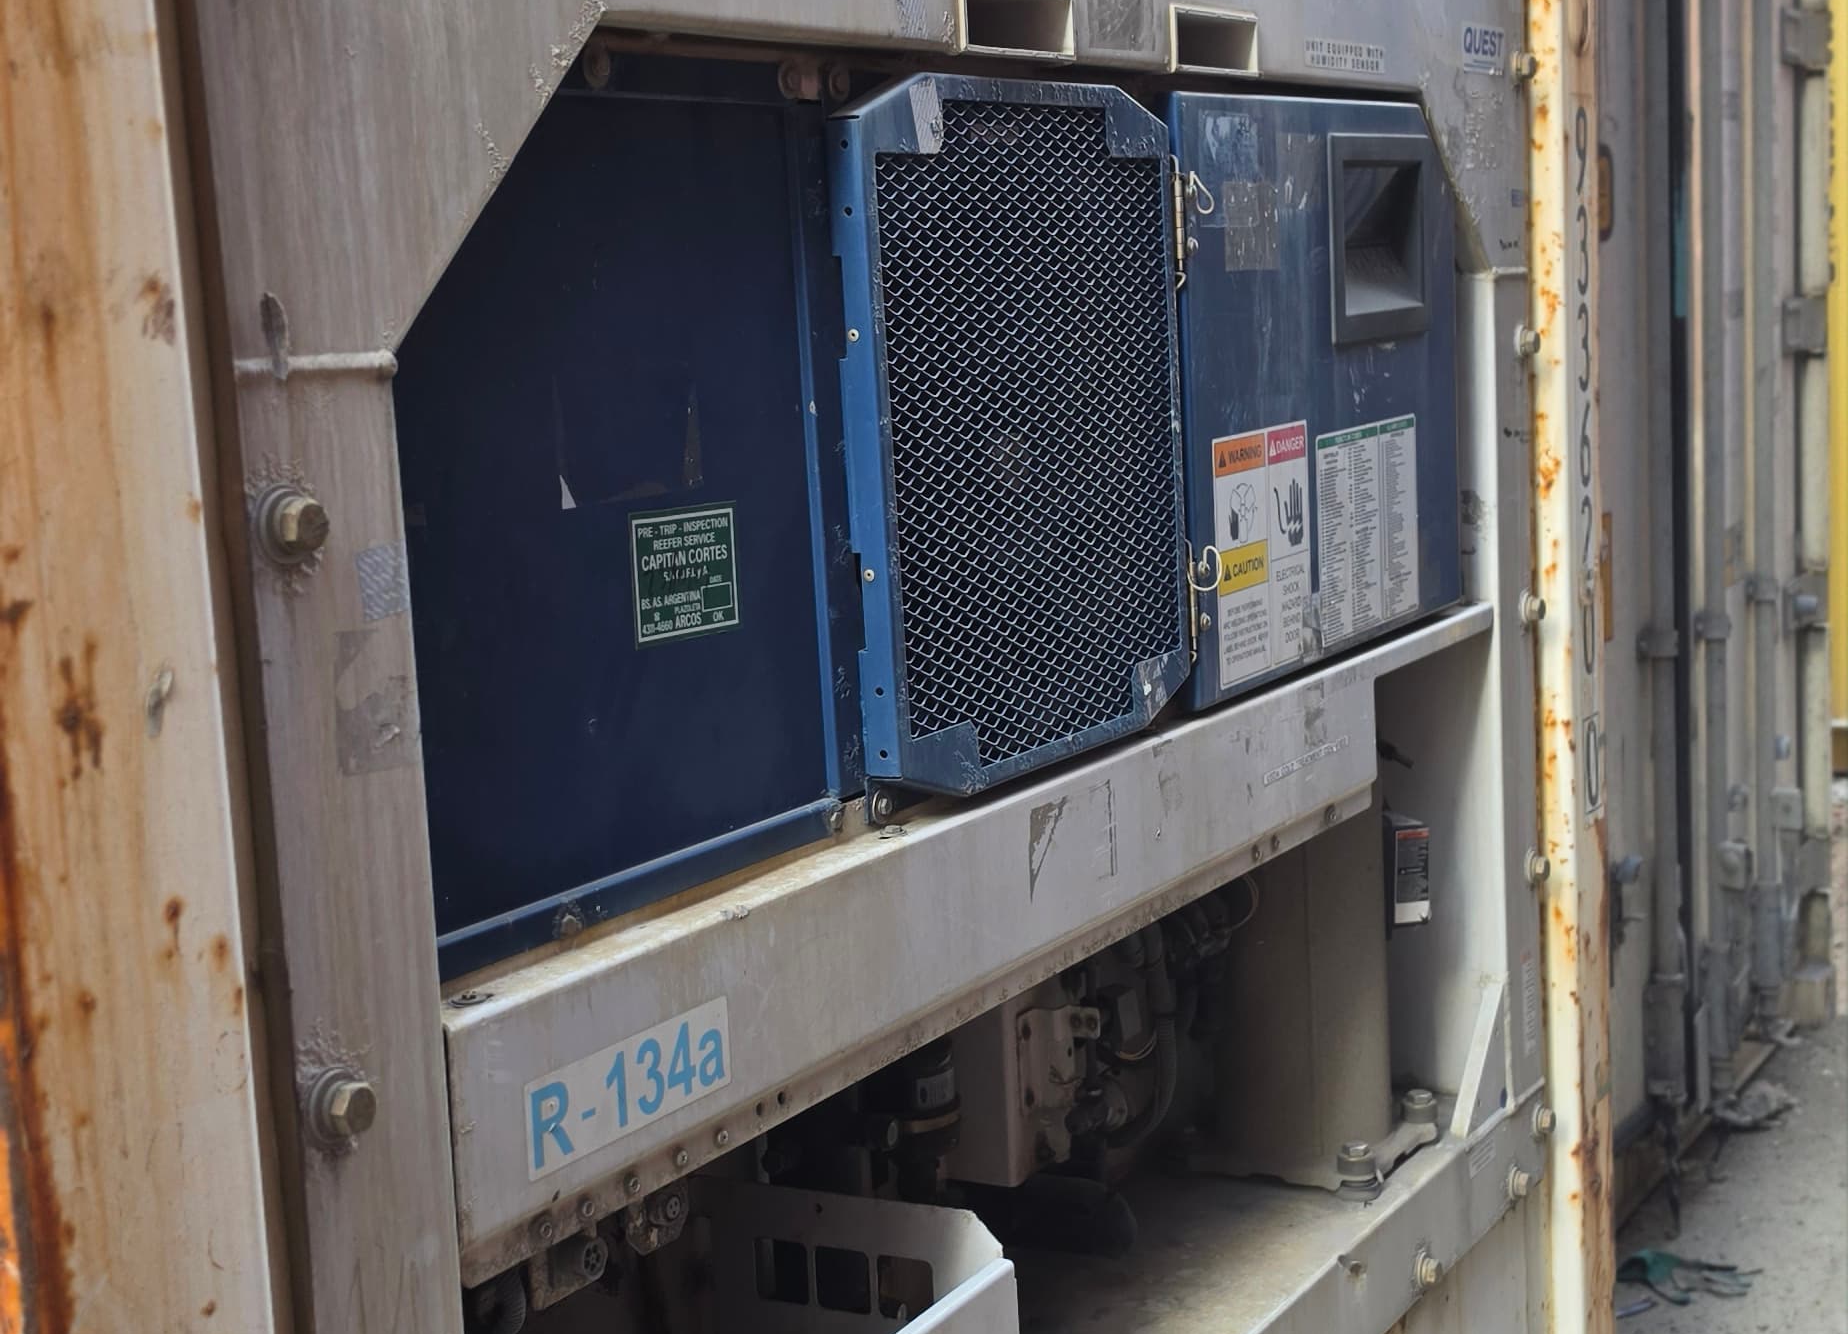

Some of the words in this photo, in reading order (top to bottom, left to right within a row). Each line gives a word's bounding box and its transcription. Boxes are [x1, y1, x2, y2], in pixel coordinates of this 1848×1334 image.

[1463, 26, 1504, 57] QUEST
[1228, 442, 1263, 464] WARNING
[1275, 435, 1305, 454] DANGER
[637, 527, 654, 540] PRE
[660, 523, 678, 536] TRIP
[683, 516, 729, 533] INSPECTION
[653, 536, 683, 551] REEFER
[683, 531, 716, 547] SERVICE
[641, 549, 687, 572] CAPITAN
[688, 543, 728, 565] CORTES
[1232, 555, 1265, 578] CAUTION
[663, 589, 701, 606] ARGENTINA
[675, 611, 702, 630] ARCOS
[712, 610, 725, 623] OK
[529, 1020, 727, 1171] R-134a
